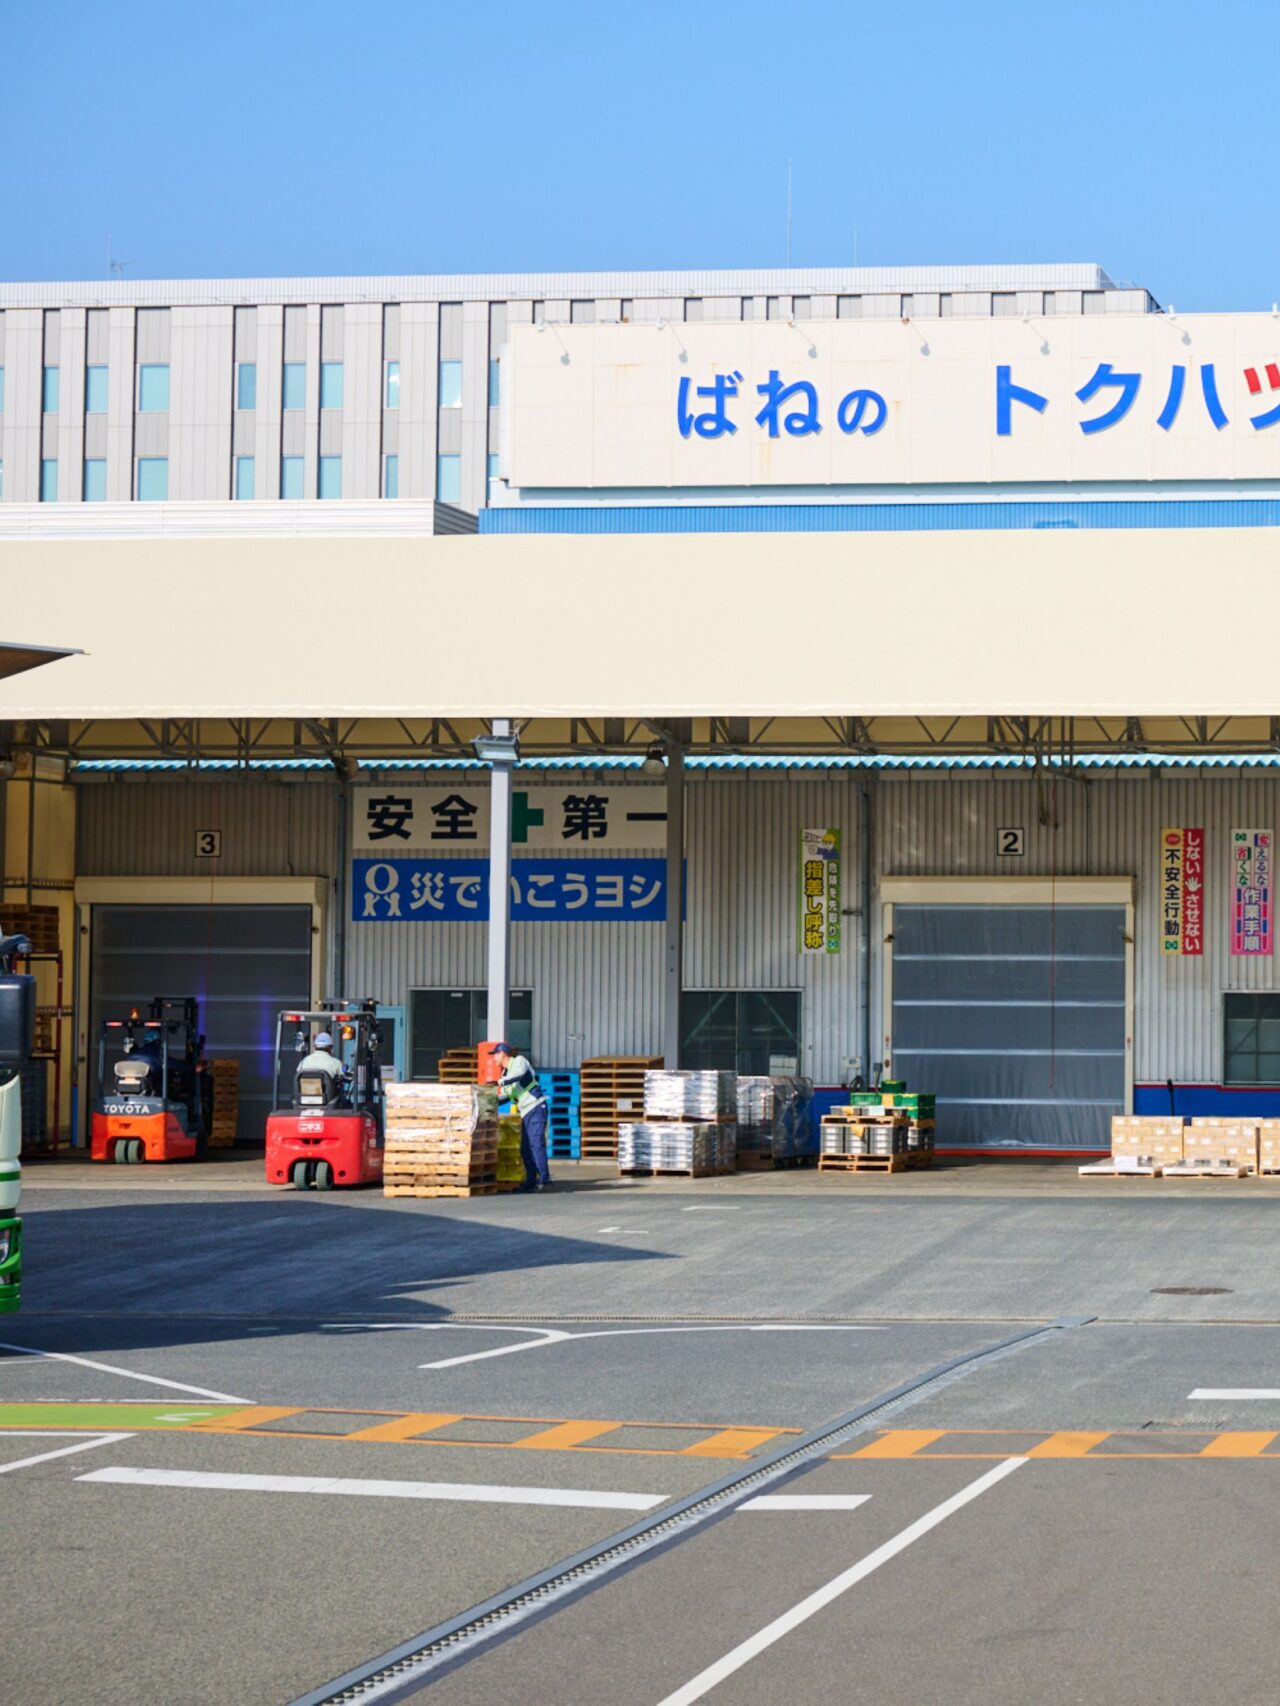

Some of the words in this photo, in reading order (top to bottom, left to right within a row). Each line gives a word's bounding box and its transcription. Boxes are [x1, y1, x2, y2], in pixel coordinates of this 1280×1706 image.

[678, 371, 886, 437] ばねの
[367, 795, 478, 840] 安全
[561, 795, 668, 840] 第一
[1003, 832, 1018, 852] 2
[201, 833, 215, 854] 3
[1186, 831, 1200, 874] しない
[805, 860, 824, 949] 指差し呼称
[1164, 849, 1181, 936] 不安全行動
[1185, 895, 1200, 951] させない
[1243, 889, 1261, 951] 作業手順
[103, 1104, 150, 1114] TOYOTA
